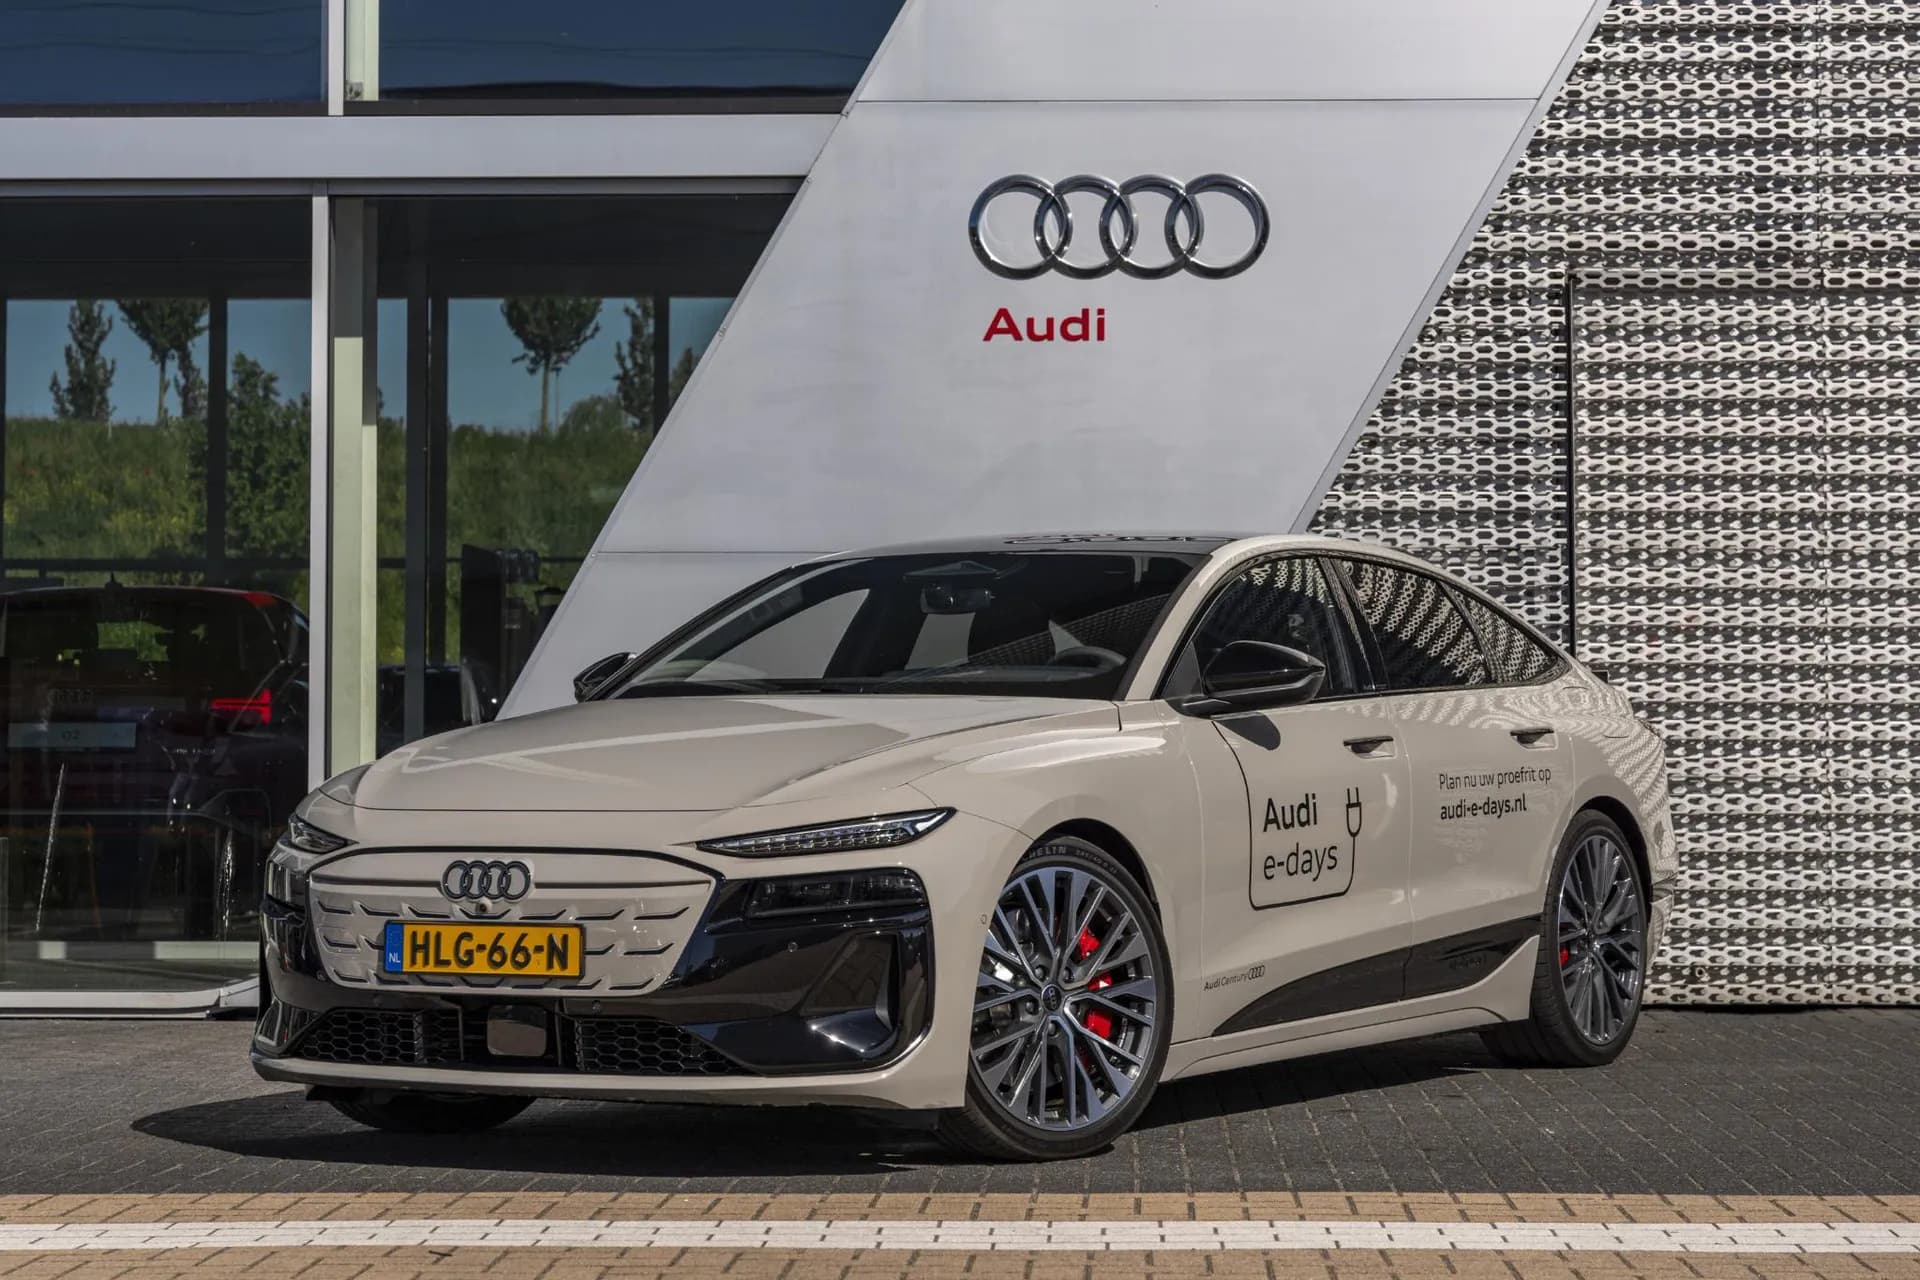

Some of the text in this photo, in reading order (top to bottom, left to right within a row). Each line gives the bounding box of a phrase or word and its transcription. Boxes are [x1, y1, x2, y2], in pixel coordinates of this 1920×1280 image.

[983, 307, 1105, 342] Audi
[1439, 766, 1552, 790] Plan nu uw proefrit op
[1263, 793, 1318, 832] Audi
[1440, 792, 1527, 820] audi-e-days.nl
[1263, 841, 1338, 882] e-days
[388, 929, 569, 971] NL HLG-66-N
